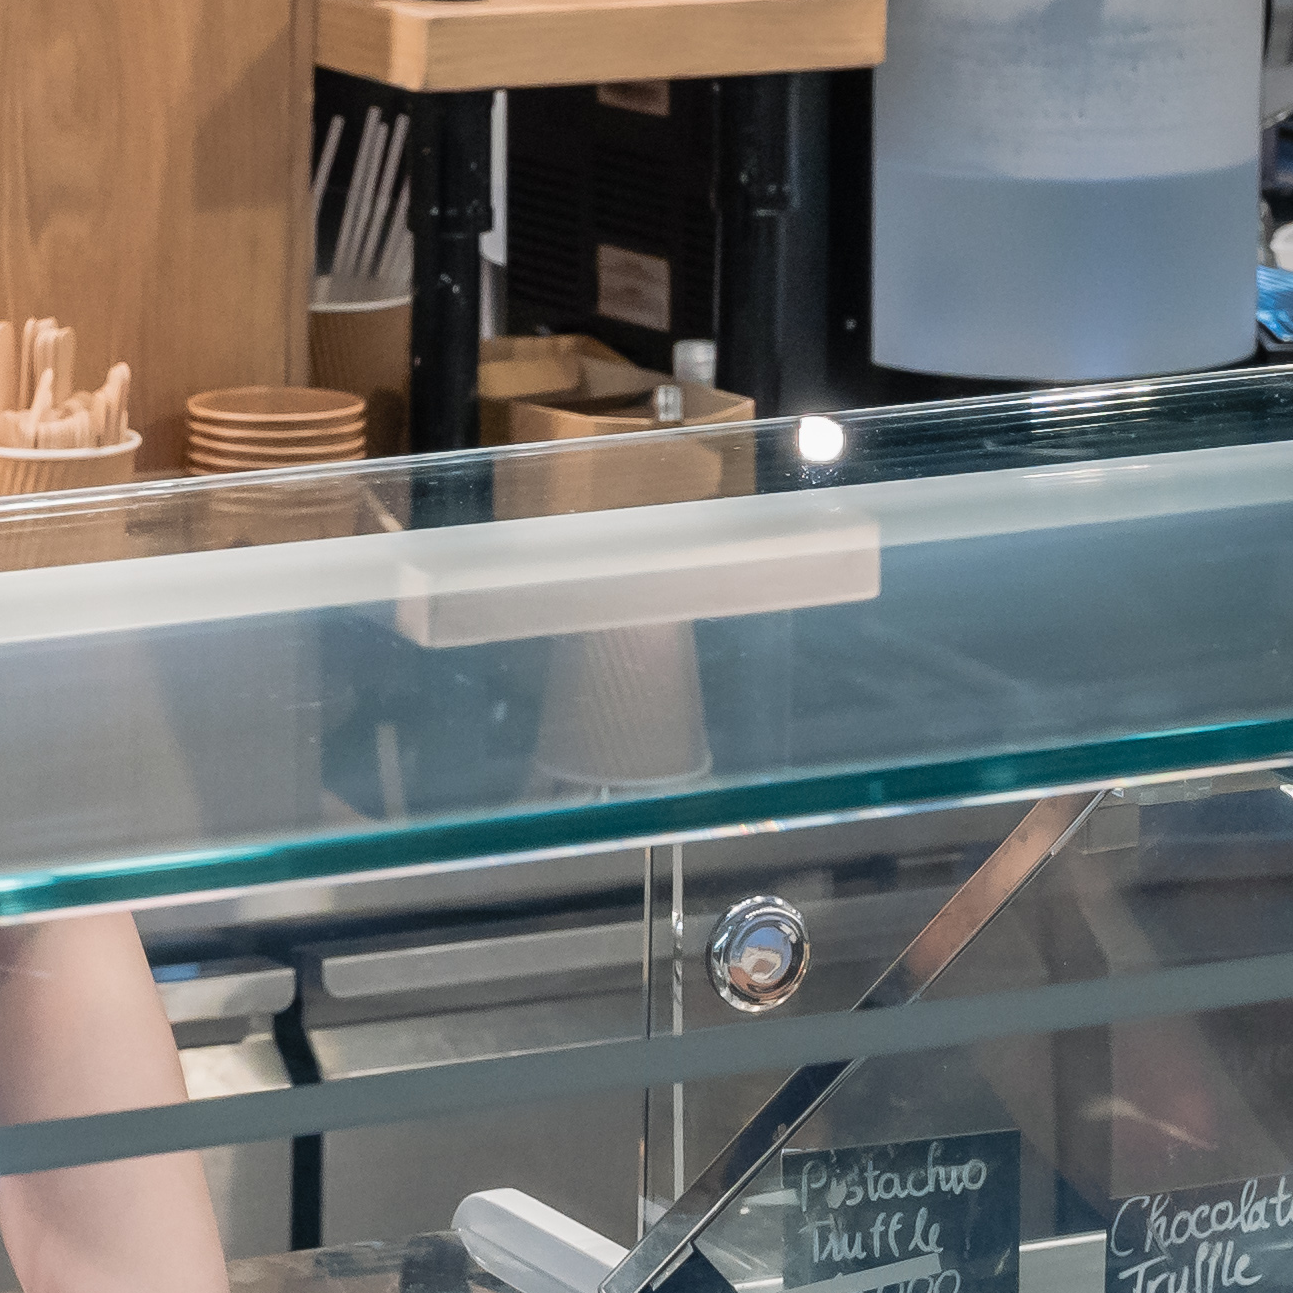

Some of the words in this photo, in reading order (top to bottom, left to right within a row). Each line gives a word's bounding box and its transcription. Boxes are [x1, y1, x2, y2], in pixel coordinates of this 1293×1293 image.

[801, 1141, 988, 1213] Pistachio
[798, 1207, 944, 1264] Truffle
[1111, 1176, 1293, 1257] Chocolat
